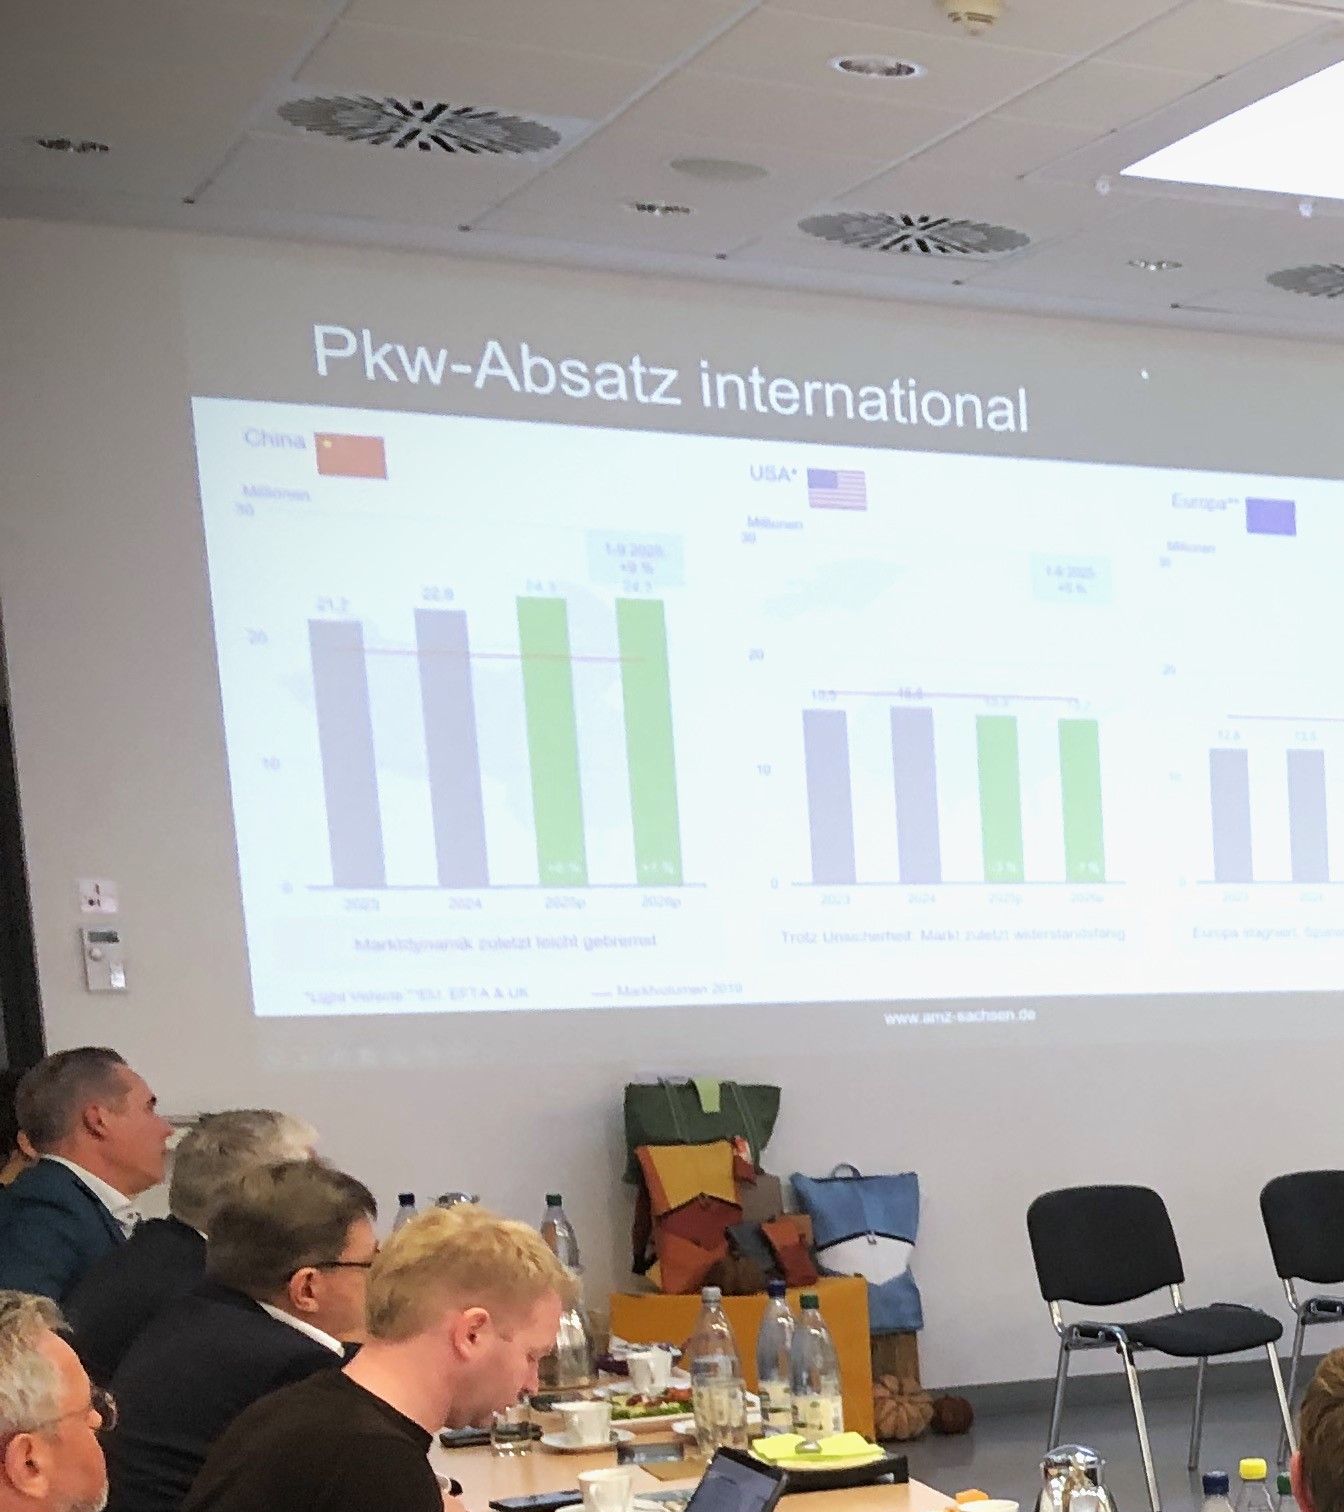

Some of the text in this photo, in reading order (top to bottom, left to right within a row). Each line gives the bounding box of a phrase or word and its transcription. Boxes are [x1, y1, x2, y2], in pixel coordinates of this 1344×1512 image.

[313, 323, 1030, 433] Pkw-Absatz international
[243, 427, 307, 450] China
[883, 1006, 1037, 1026] www.amz-sachsen.de
